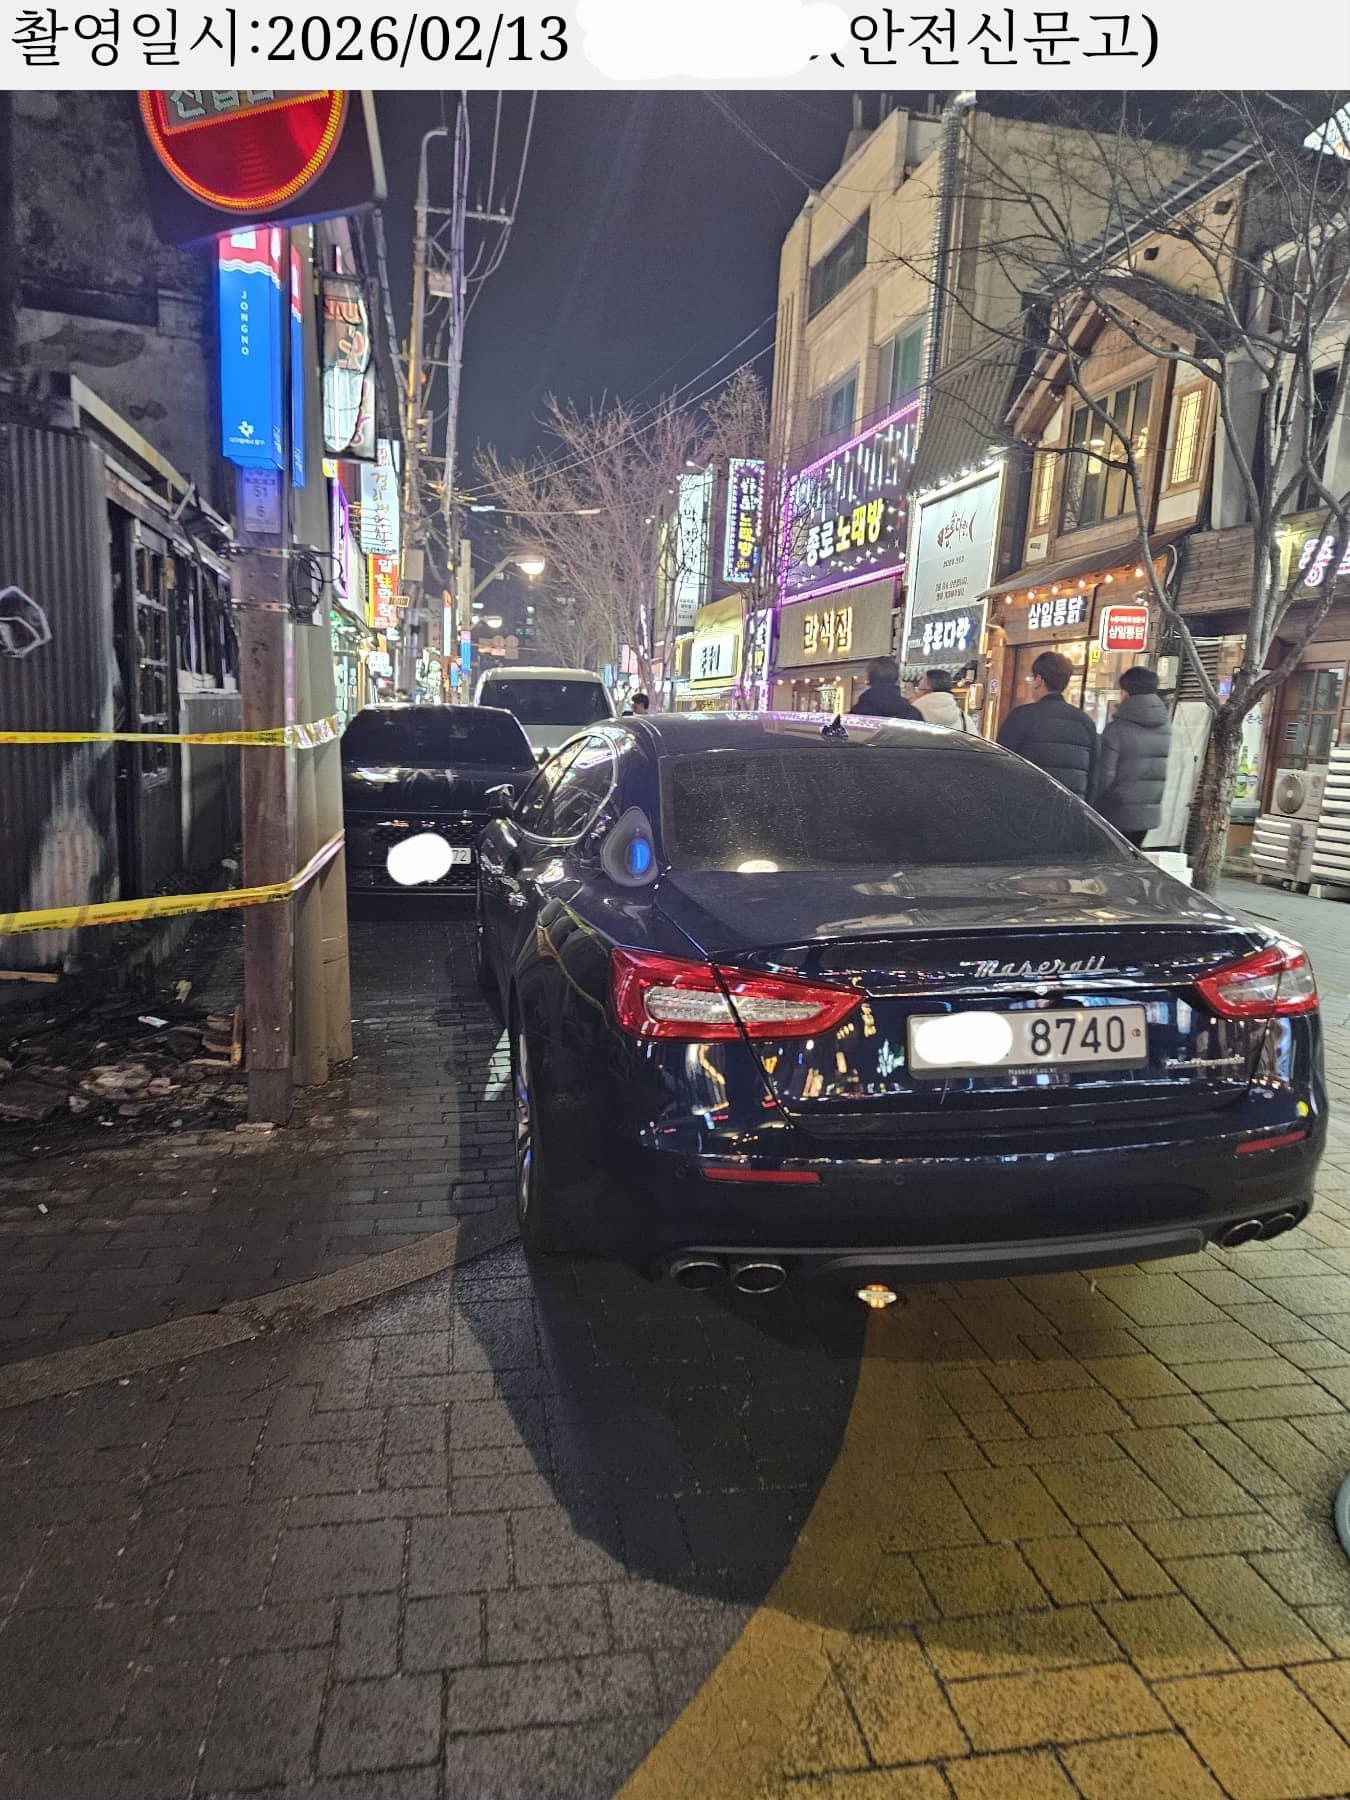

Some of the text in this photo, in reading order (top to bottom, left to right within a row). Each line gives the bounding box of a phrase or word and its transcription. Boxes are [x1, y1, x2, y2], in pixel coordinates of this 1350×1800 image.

[240, 290, 249, 356] JONGNO
[806, 497, 885, 568] 종로노래방
[1028, 595, 1084, 630] 삼일통닭
[1108, 625, 1145, 640] 삼일통닭
[922, 616, 971, 657] 종로다랑
[974, 955, 1120, 978] Maserati
[1030, 1015, 1126, 1057] 8740
